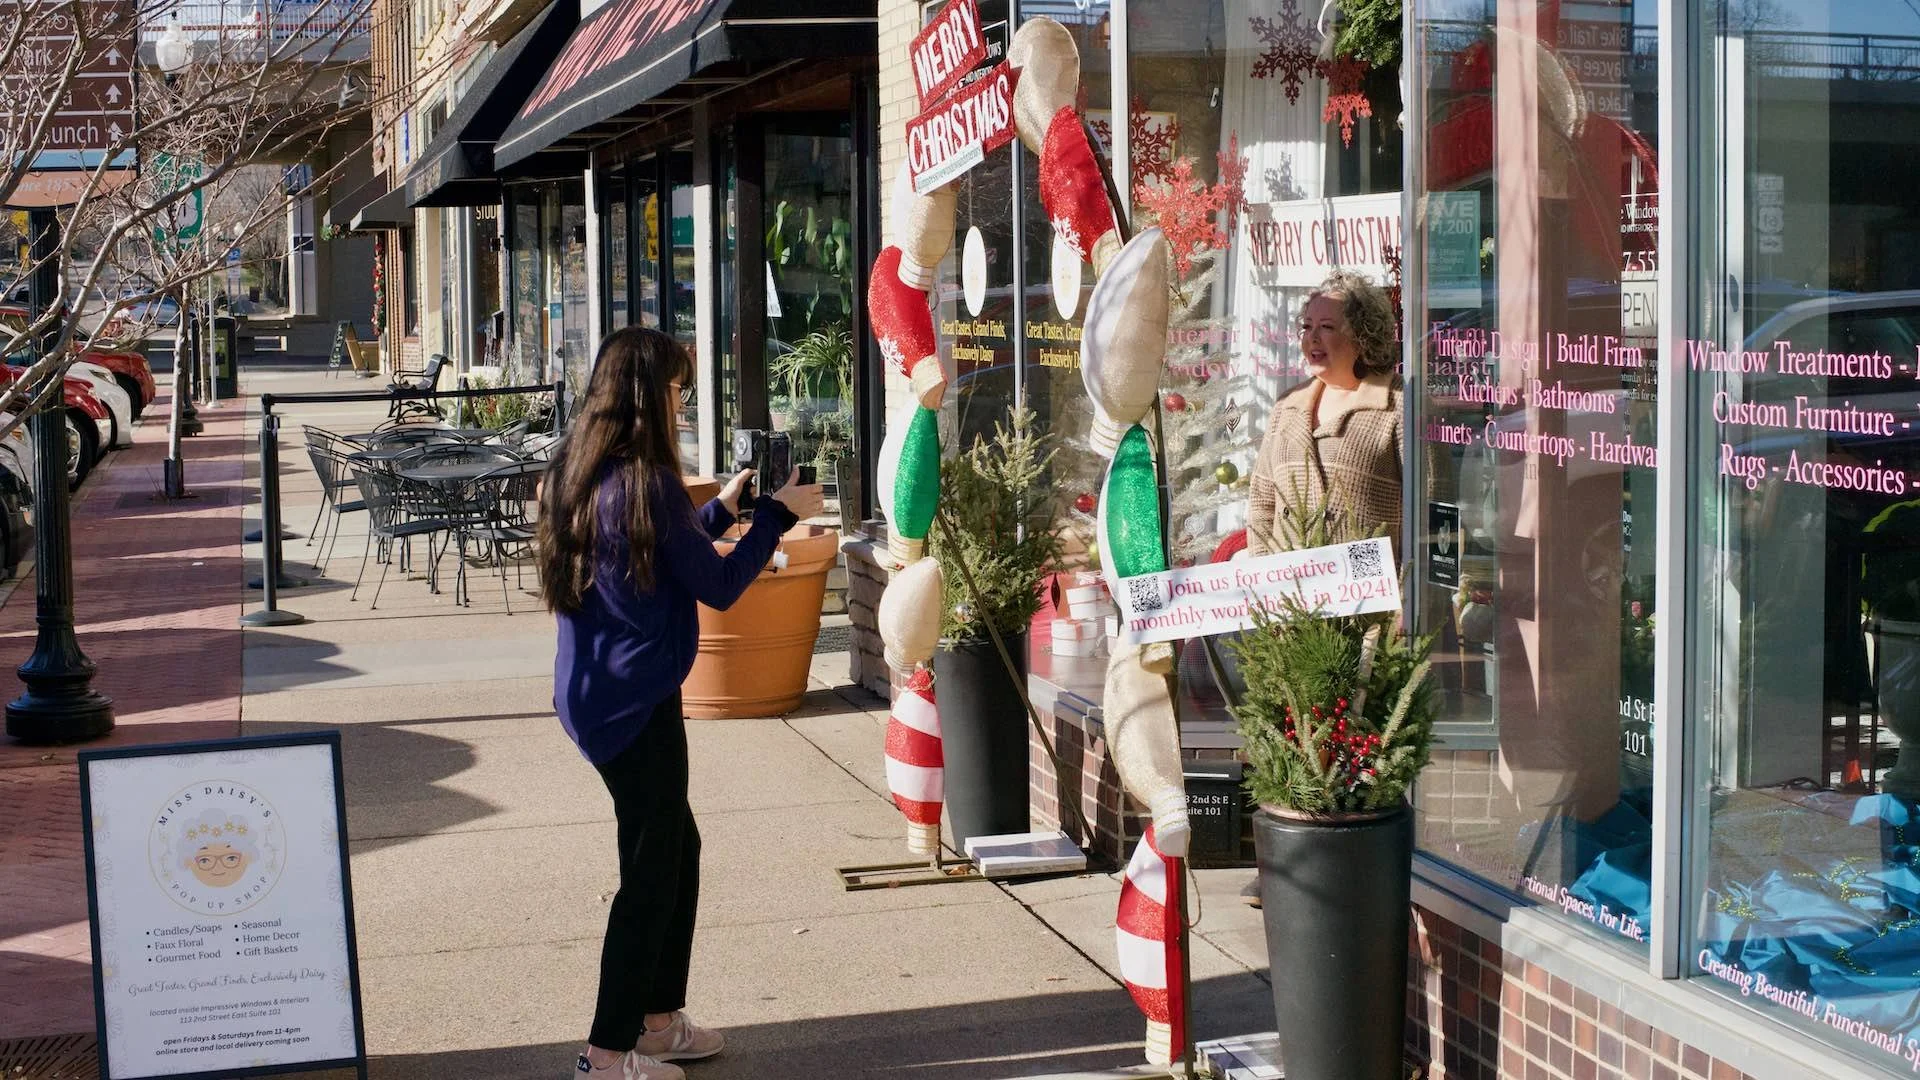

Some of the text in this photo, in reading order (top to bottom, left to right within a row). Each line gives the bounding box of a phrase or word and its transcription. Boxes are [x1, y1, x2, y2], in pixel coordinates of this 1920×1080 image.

[914, 0, 978, 98] MERRY
[30, 119, 98, 143] Lunch
[909, 74, 1009, 173] CHRISTMAS
[1250, 221, 1303, 266] MERRY
[940, 320, 955, 336] Great
[973, 320, 989, 336] Grand
[1026, 321, 1043, 338] Great
[1044, 322, 1065, 342] Tastes,
[952, 344, 994, 367] Exclusively Daisy
[1040, 349, 1073, 373] Exclusively
[1437, 332, 1487, 358] Interior
[1557, 333, 1599, 364] Build
[1604, 336, 1642, 368] Firm
[1688, 339, 1768, 373] Window
[1774, 341, 1892, 379] Treatments
[1458, 375, 1518, 406] Kitchens
[1532, 379, 1615, 414] Bathrooms
[1713, 391, 1788, 428] Custom
[1795, 396, 1895, 437] Furniture
[1485, 420, 1575, 467] Countertops
[1720, 443, 1766, 490] Rugs
[1784, 449, 1905, 495] Accessories
[1167, 558, 1337, 601] Join us for creative
[1130, 606, 1205, 633] monthly
[1314, 588, 1332, 607] in
[1337, 577, 1392, 603] 2024!
[1633, 698, 1646, 721] St
[1624, 730, 1647, 756] 101
[158, 786, 271, 826] MISS DAISY'S
[1192, 795, 1210, 804] 2nd
[1211, 795, 1220, 804] St
[1223, 796, 1229, 804] E
[1205, 807, 1221, 815] 101
[172, 876, 267, 909] POP UP SHOP
[241, 918, 282, 930] Seasonal
[1559, 886, 1596, 923] Spaces,
[1599, 903, 1617, 930] For
[1620, 912, 1643, 942] Life.
[153, 924, 223, 937] Candles/Soaps
[243, 931, 301, 943] Home Decor
[155, 938, 204, 951] Faux Floral
[155, 949, 221, 964] Gourmet Food
[243, 943, 298, 957] Gift Baskets
[150, 1008, 177, 1017] located
[178, 1006, 199, 1015] inside
[200, 1002, 239, 1014] Impressive
[240, 999, 272, 1009] Windows
[280, 997, 310, 1005] Interiors
[1699, 948, 1752, 997] Creating
[1755, 971, 1818, 1023] Beautiful,
[1823, 1003, 1904, 1056] Functional
[193, 1015, 208, 1024] 2nd
[208, 1013, 230, 1022] Street
[231, 1011, 248, 1020] East
[249, 1010, 267, 1019] Suite
[268, 1008, 281, 1017] 101
[155, 1035, 310, 1057] online store and local delivery coming soon
[163, 1026, 301, 1047] open Fridays & Saturdays from 11-4pm
